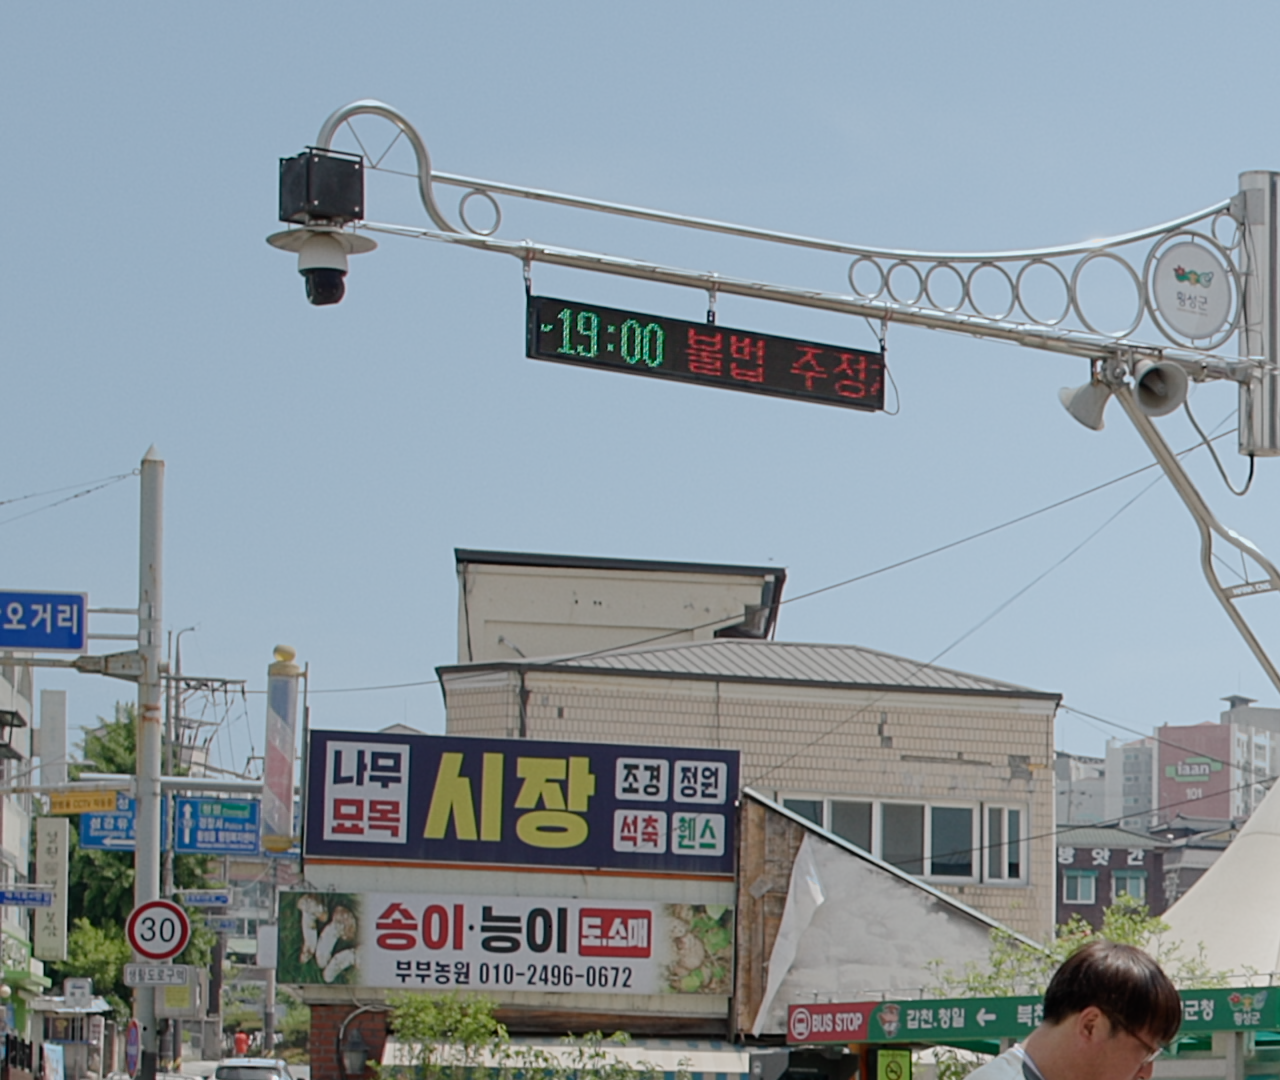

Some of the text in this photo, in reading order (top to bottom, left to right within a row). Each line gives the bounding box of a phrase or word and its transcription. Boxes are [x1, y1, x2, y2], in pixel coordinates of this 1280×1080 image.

[686, 327, 765, 383] 불법
[0, 603, 79, 634] 오거리
[332, 749, 402, 788] 나무
[622, 764, 661, 796] 조경
[679, 765, 719, 799] 정원
[1177, 762, 1210, 776] iaan
[423, 752, 596, 849] 시장
[331, 798, 402, 837] 묘목
[619, 814, 659, 848] 석축
[1058, 846, 1145, 866] 방앗간
[140, 916, 175, 945] 30
[375, 902, 568, 955] 송이·능이
[127, 966, 187, 984] 생활도로구역
[395, 961, 633, 988] 부부농원 010-2496-0672
[811, 1013, 862, 1032] BUS STOP
[906, 1008, 966, 1029] 갑천.청일
[1179, 1000, 1212, 1021] 군청
[1233, 1011, 1261, 1026] 횡성군
